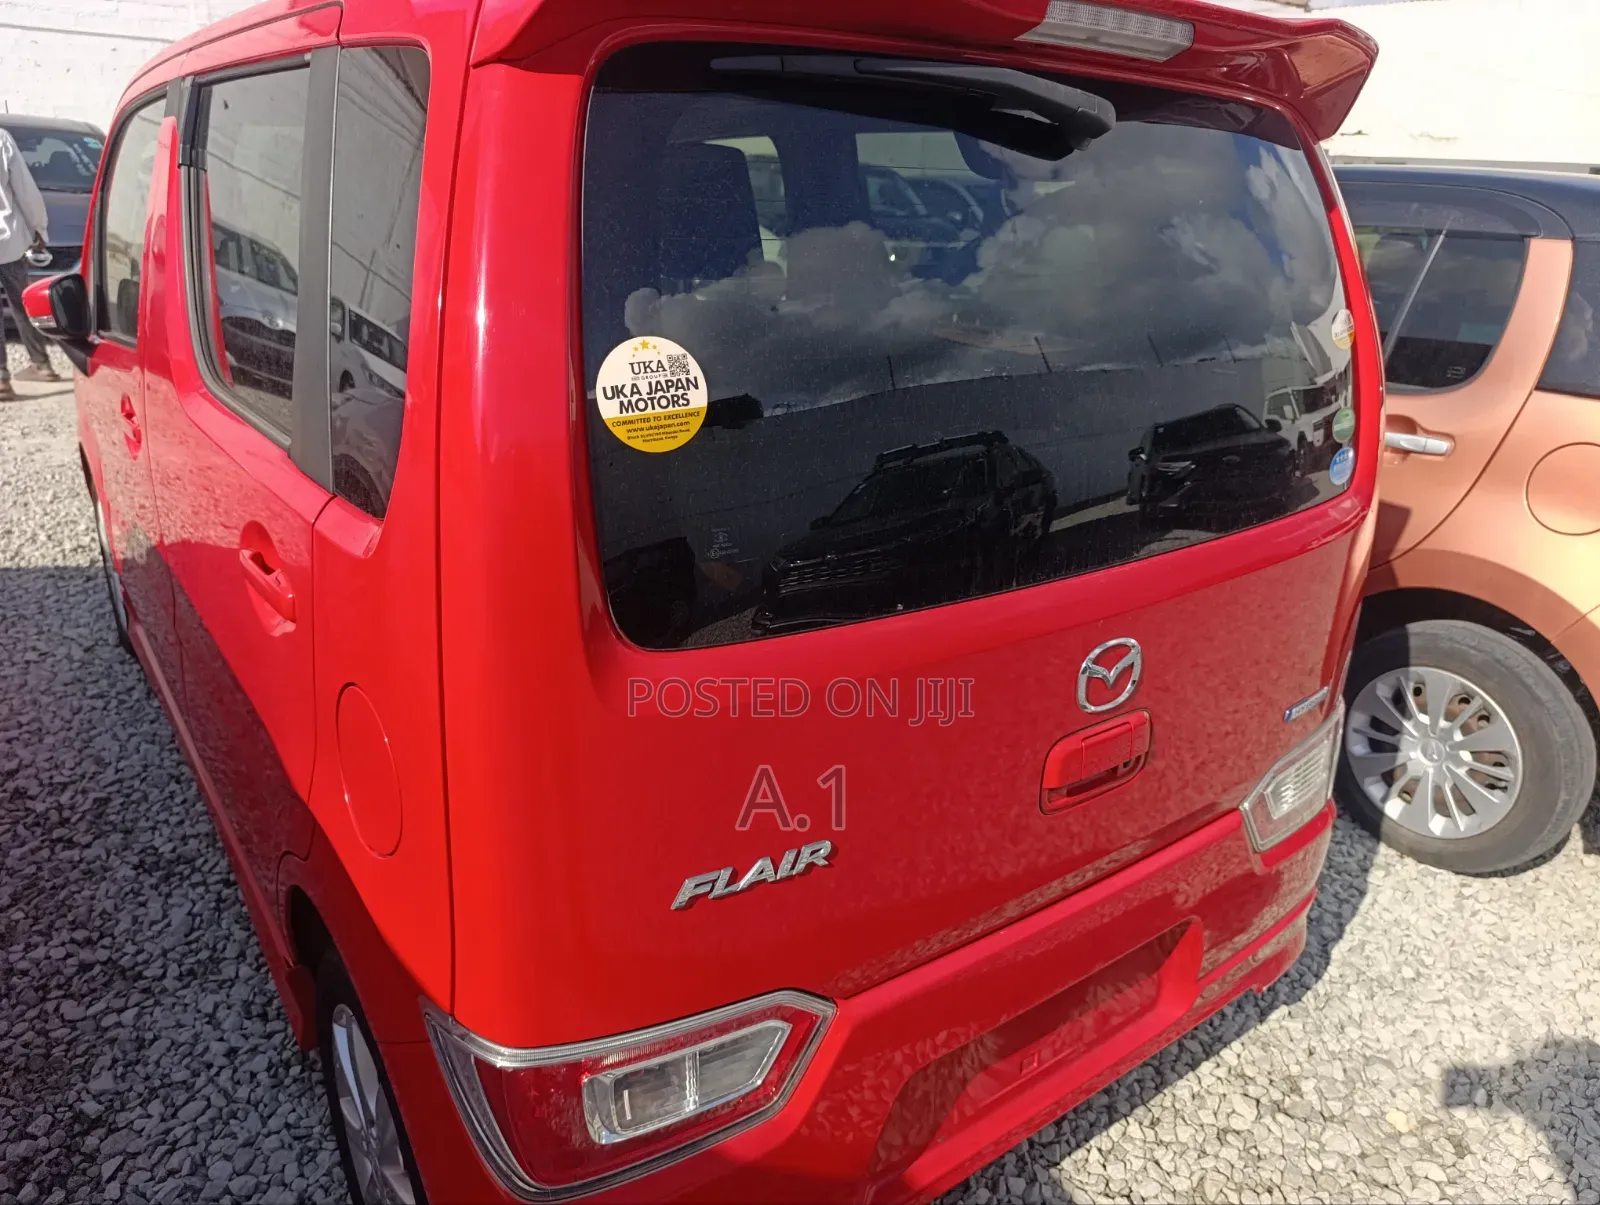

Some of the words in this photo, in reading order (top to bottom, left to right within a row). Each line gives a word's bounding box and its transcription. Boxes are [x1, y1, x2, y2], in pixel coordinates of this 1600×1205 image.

[629, 360, 667, 375] UKA
[602, 383, 642, 400] UKA
[646, 376, 699, 395] JAPAN
[619, 393, 690, 414] MOTORS
[612, 417, 651, 427] COMMITTED
[664, 411, 700, 421] EXCELLENCE
[626, 421, 691, 433] www.ukajapan.com
[670, 839, 832, 910] FLAIR
